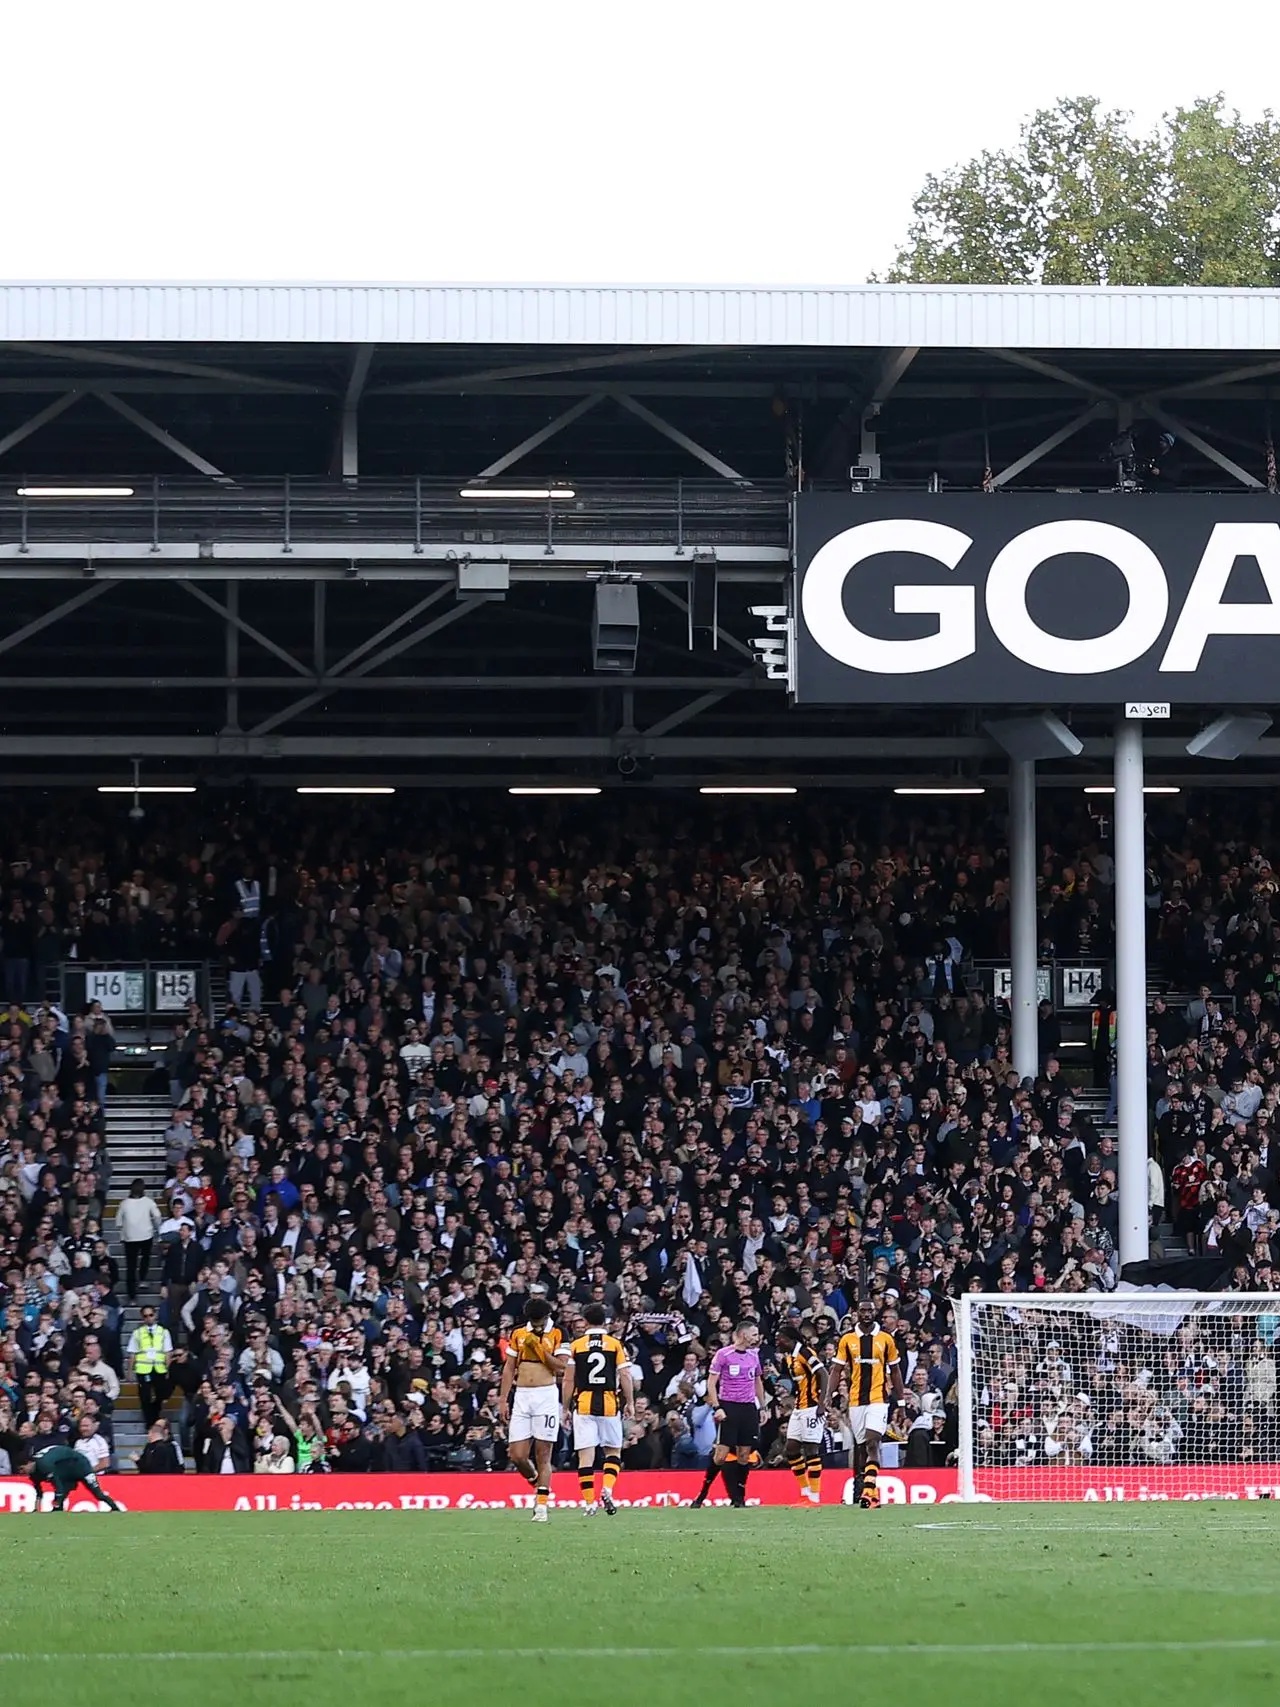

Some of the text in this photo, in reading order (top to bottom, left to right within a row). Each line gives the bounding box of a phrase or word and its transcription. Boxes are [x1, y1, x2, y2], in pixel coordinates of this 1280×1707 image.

[1129, 704, 1167, 717] Absen
[94, 977, 122, 996] H6
[161, 976, 189, 996] H5
[1068, 972, 1096, 993] H4
[587, 1352, 606, 1384] 2
[544, 1415, 556, 1429] 10
[806, 1417, 816, 1429] 18
